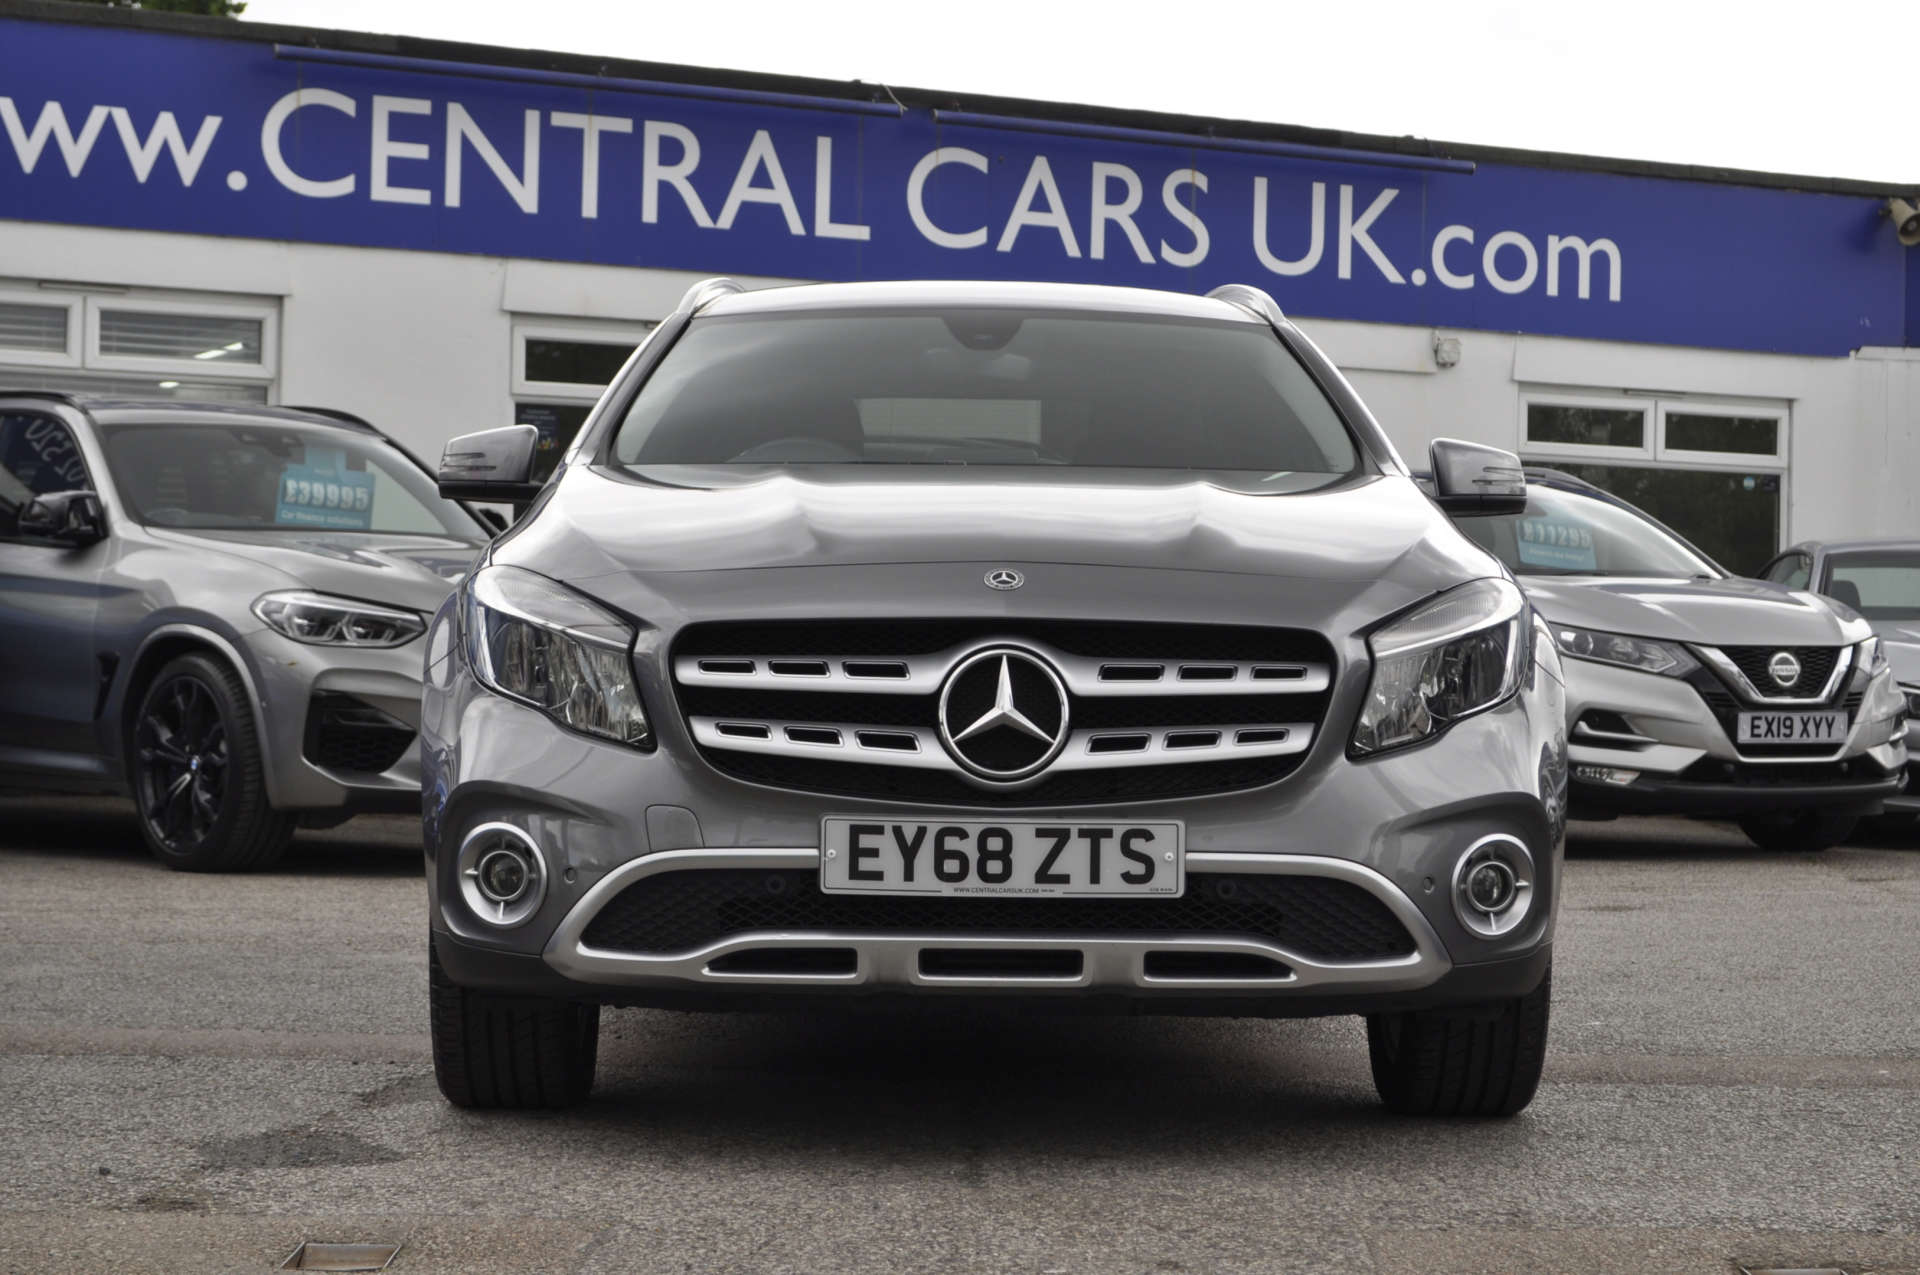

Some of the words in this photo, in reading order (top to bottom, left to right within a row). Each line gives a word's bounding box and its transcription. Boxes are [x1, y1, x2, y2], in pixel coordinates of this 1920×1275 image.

[906, 147, 1210, 268] CARS
[1252, 176, 1622, 302] UK.com
[1750, 715, 1794, 739] EX19
[1799, 715, 1836, 739] XYY
[848, 823, 1014, 884] EY68
[1034, 827, 1156, 885] ZTS
